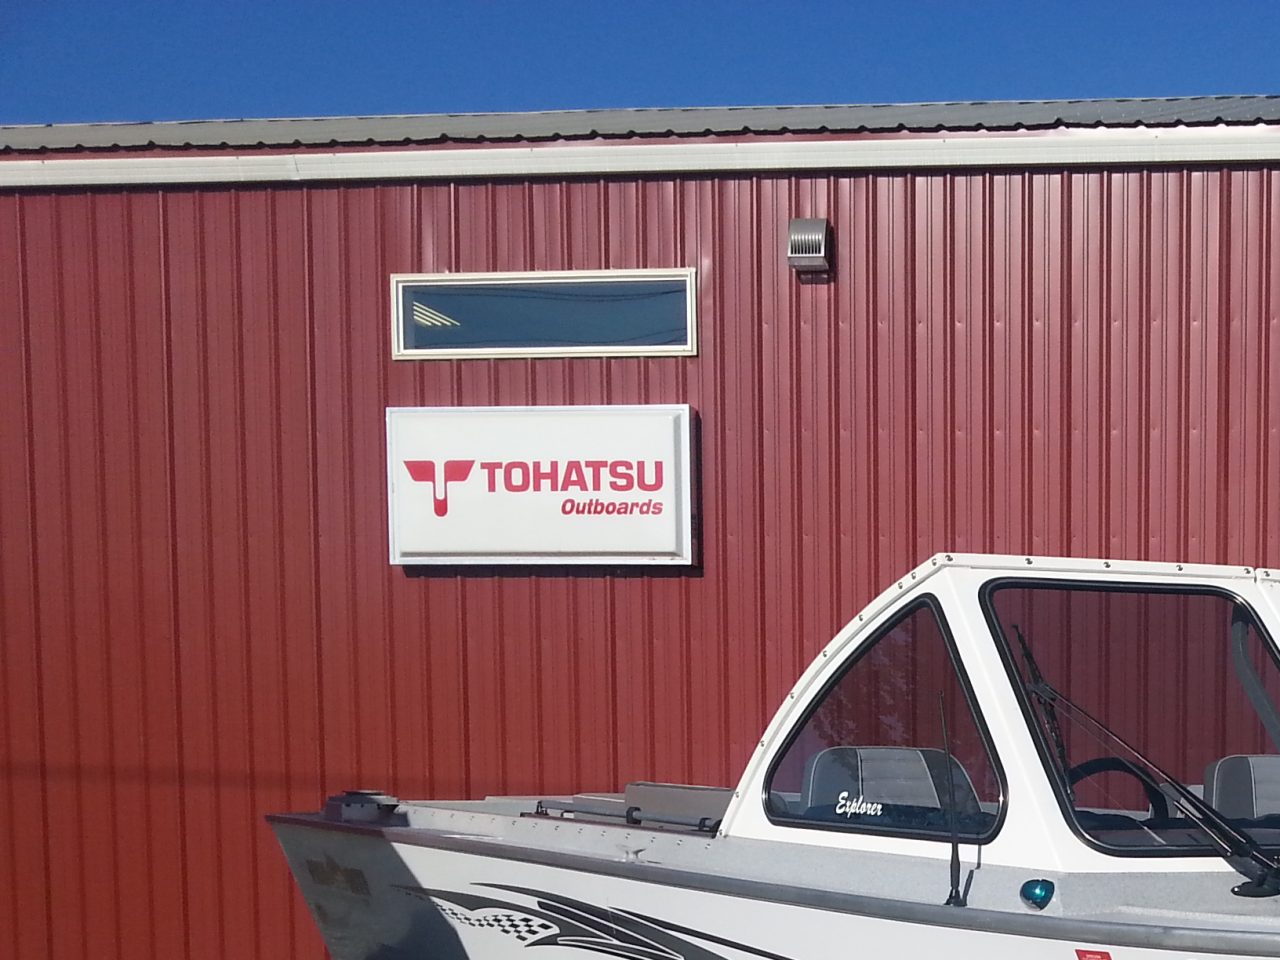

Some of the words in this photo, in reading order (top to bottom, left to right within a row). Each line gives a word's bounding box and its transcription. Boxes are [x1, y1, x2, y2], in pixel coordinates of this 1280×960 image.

[480, 461, 663, 492] TOHATSU
[561, 498, 663, 515] Outboards
[836, 791, 882, 818] Explorer
